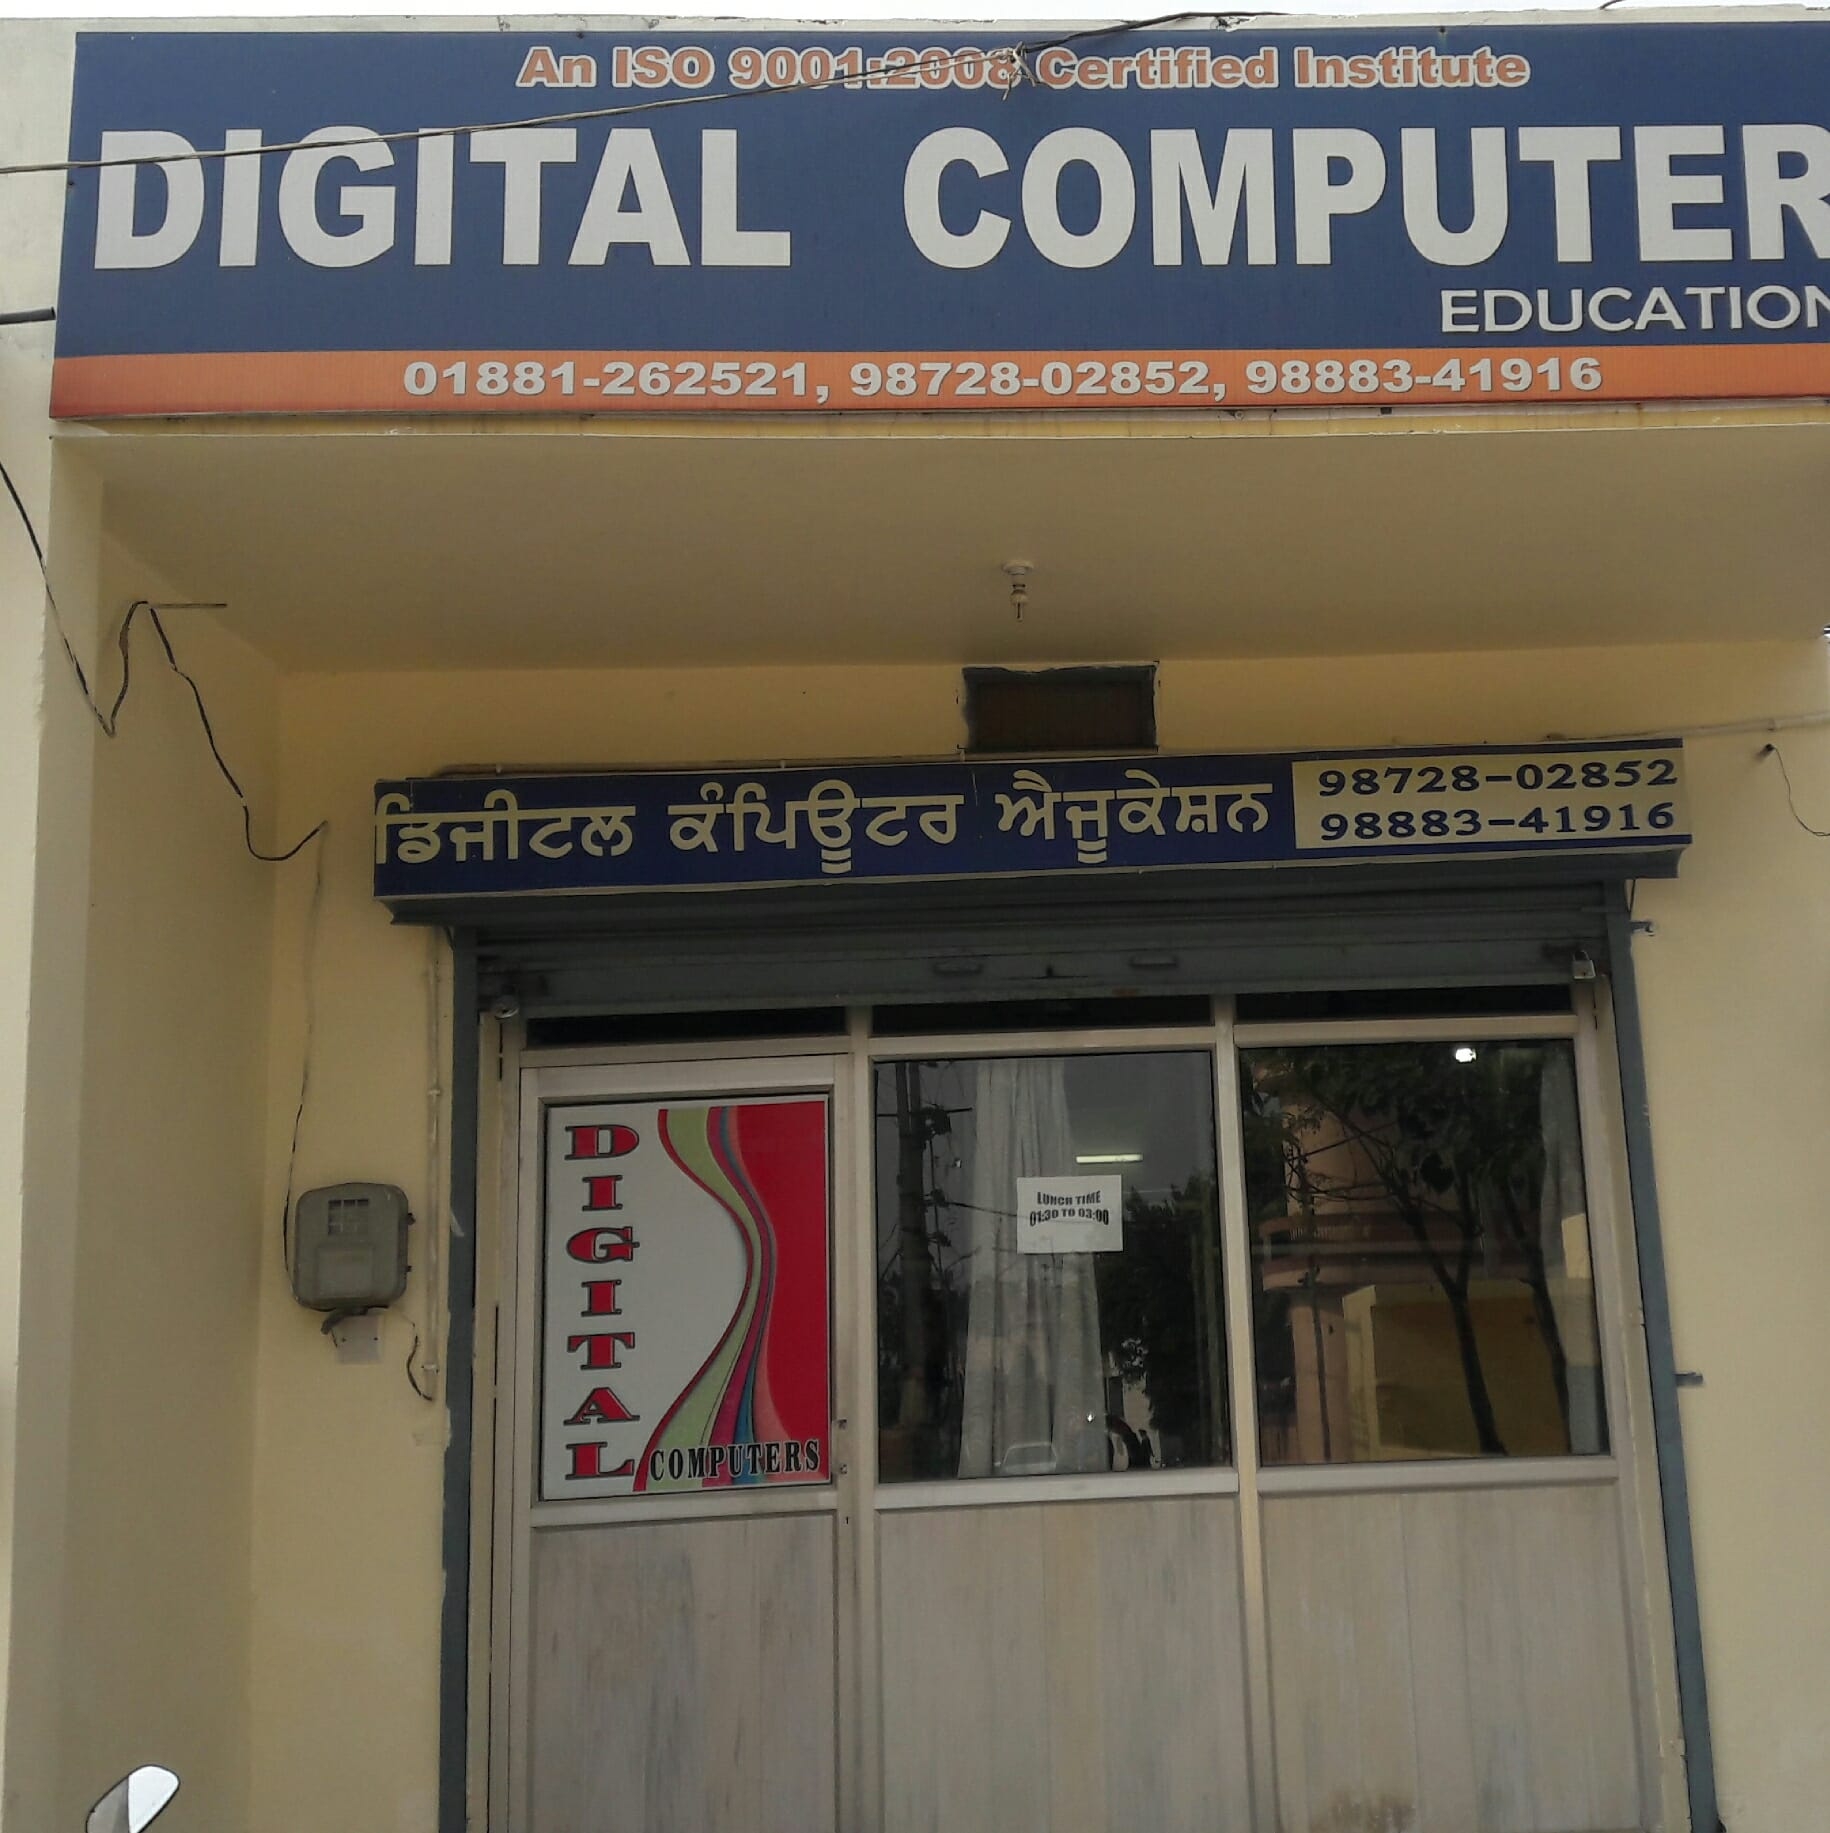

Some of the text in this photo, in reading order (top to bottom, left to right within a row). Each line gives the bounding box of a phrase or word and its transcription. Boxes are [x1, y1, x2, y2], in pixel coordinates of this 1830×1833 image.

[517, 44, 1531, 90] An ISO 9001:2008 Certified Institute
[94, 123, 1830, 271] DIGITAL COMPUTER
[402, 356, 1602, 406] 01881-262521, 98728-02852, 98883-41916
[1318, 758, 1679, 797] 98728-02852
[375, 768, 1274, 875] ਡਿਜੀਟਲ ਕੰਪਿਊਟਰ ਐਜੂਕੇਸ਼ਨ
[1319, 801, 1676, 843] 98883-41916
[1029, 1208, 1109, 1227] 01:30 TO 03:00
[1037, 1190, 1101, 1205] LUNCH TIME
[563, 1123, 640, 1481] DIGITAL
[649, 1439, 820, 1482] COMPUTERS
